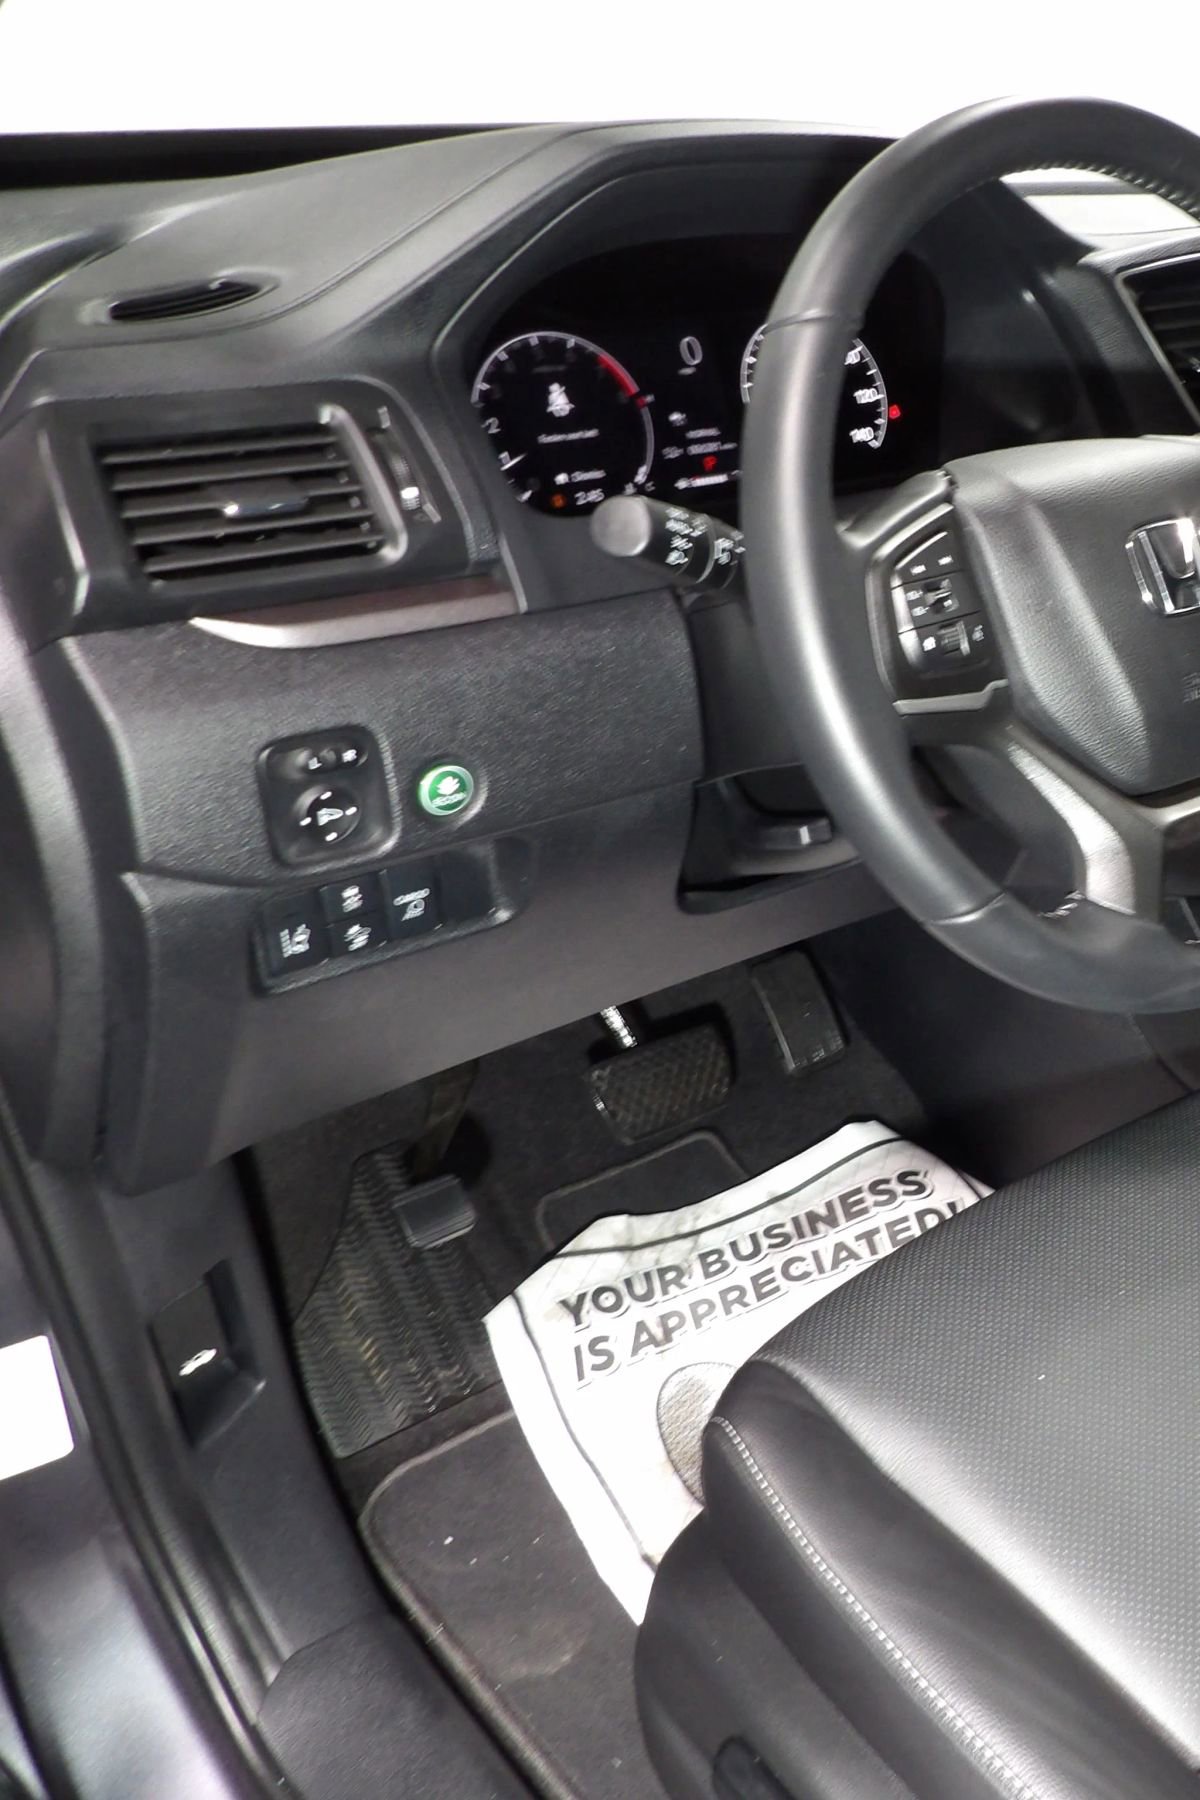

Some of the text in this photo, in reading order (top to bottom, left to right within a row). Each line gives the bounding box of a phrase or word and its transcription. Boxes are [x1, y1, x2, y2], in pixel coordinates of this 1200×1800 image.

[679, 336, 703, 366] 0
[481, 417, 501, 434] 2
[557, 1169, 930, 1328] YOUR BUSINESS
[573, 1334, 616, 1383] IS
